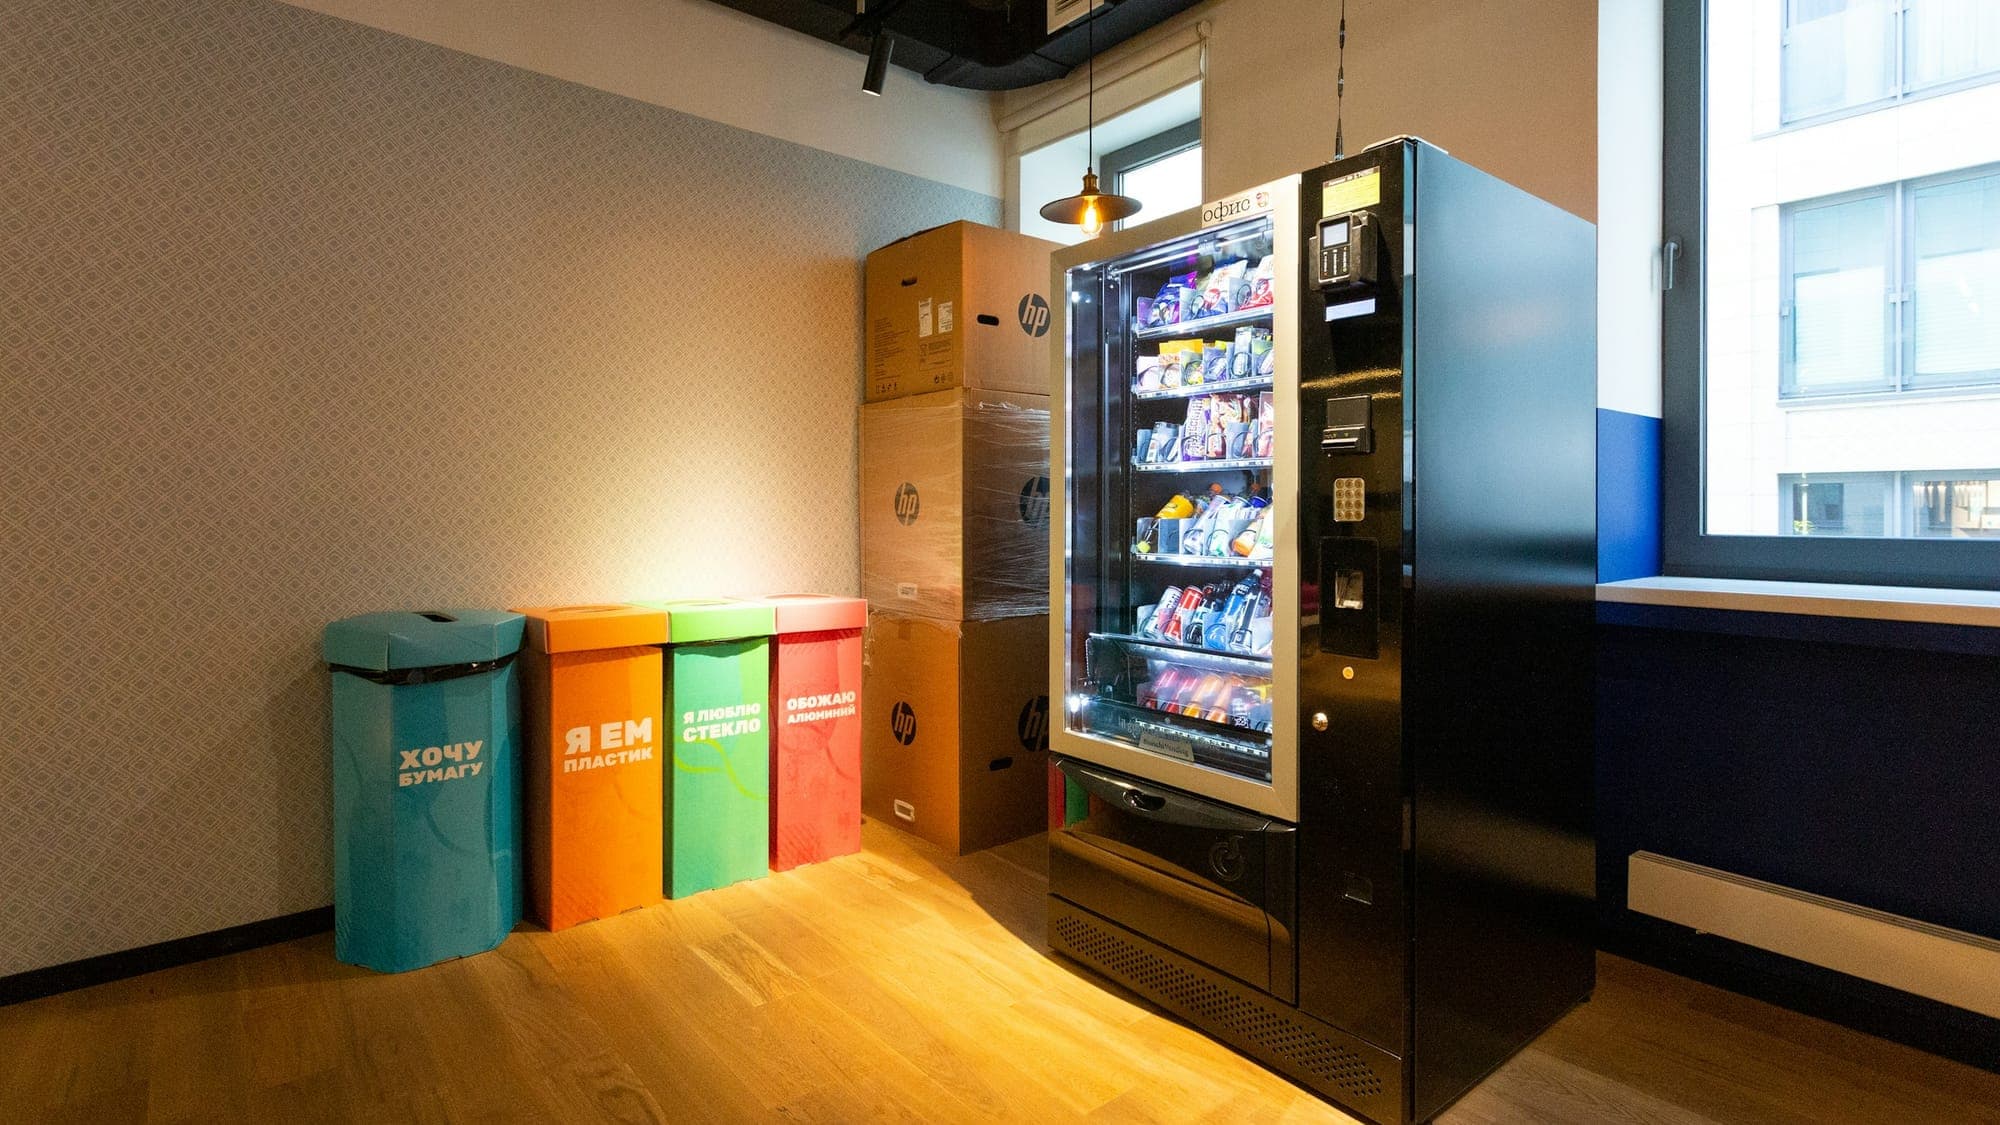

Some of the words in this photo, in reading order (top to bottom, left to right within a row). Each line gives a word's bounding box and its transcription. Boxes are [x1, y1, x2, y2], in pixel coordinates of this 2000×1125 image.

[1203, 199, 1250, 222] офис
[1021, 293, 1049, 337] hp
[898, 482, 917, 526] hp
[683, 711, 693, 724] Я
[697, 703, 761, 722] ЛЮБЛЮ
[787, 691, 856, 711] ОБОЖАЮ
[787, 704, 856, 724] АЛЮМИНИЙ
[683, 718, 761, 742] СТЕКЛО
[895, 701, 914, 744] hp
[564, 726, 591, 755] Я
[601, 717, 653, 750] ЕМ
[399, 740, 483, 770] ХОЧУ
[564, 747, 654, 773] ПЛАСТИК
[399, 761, 483, 787] БУМАГУ
